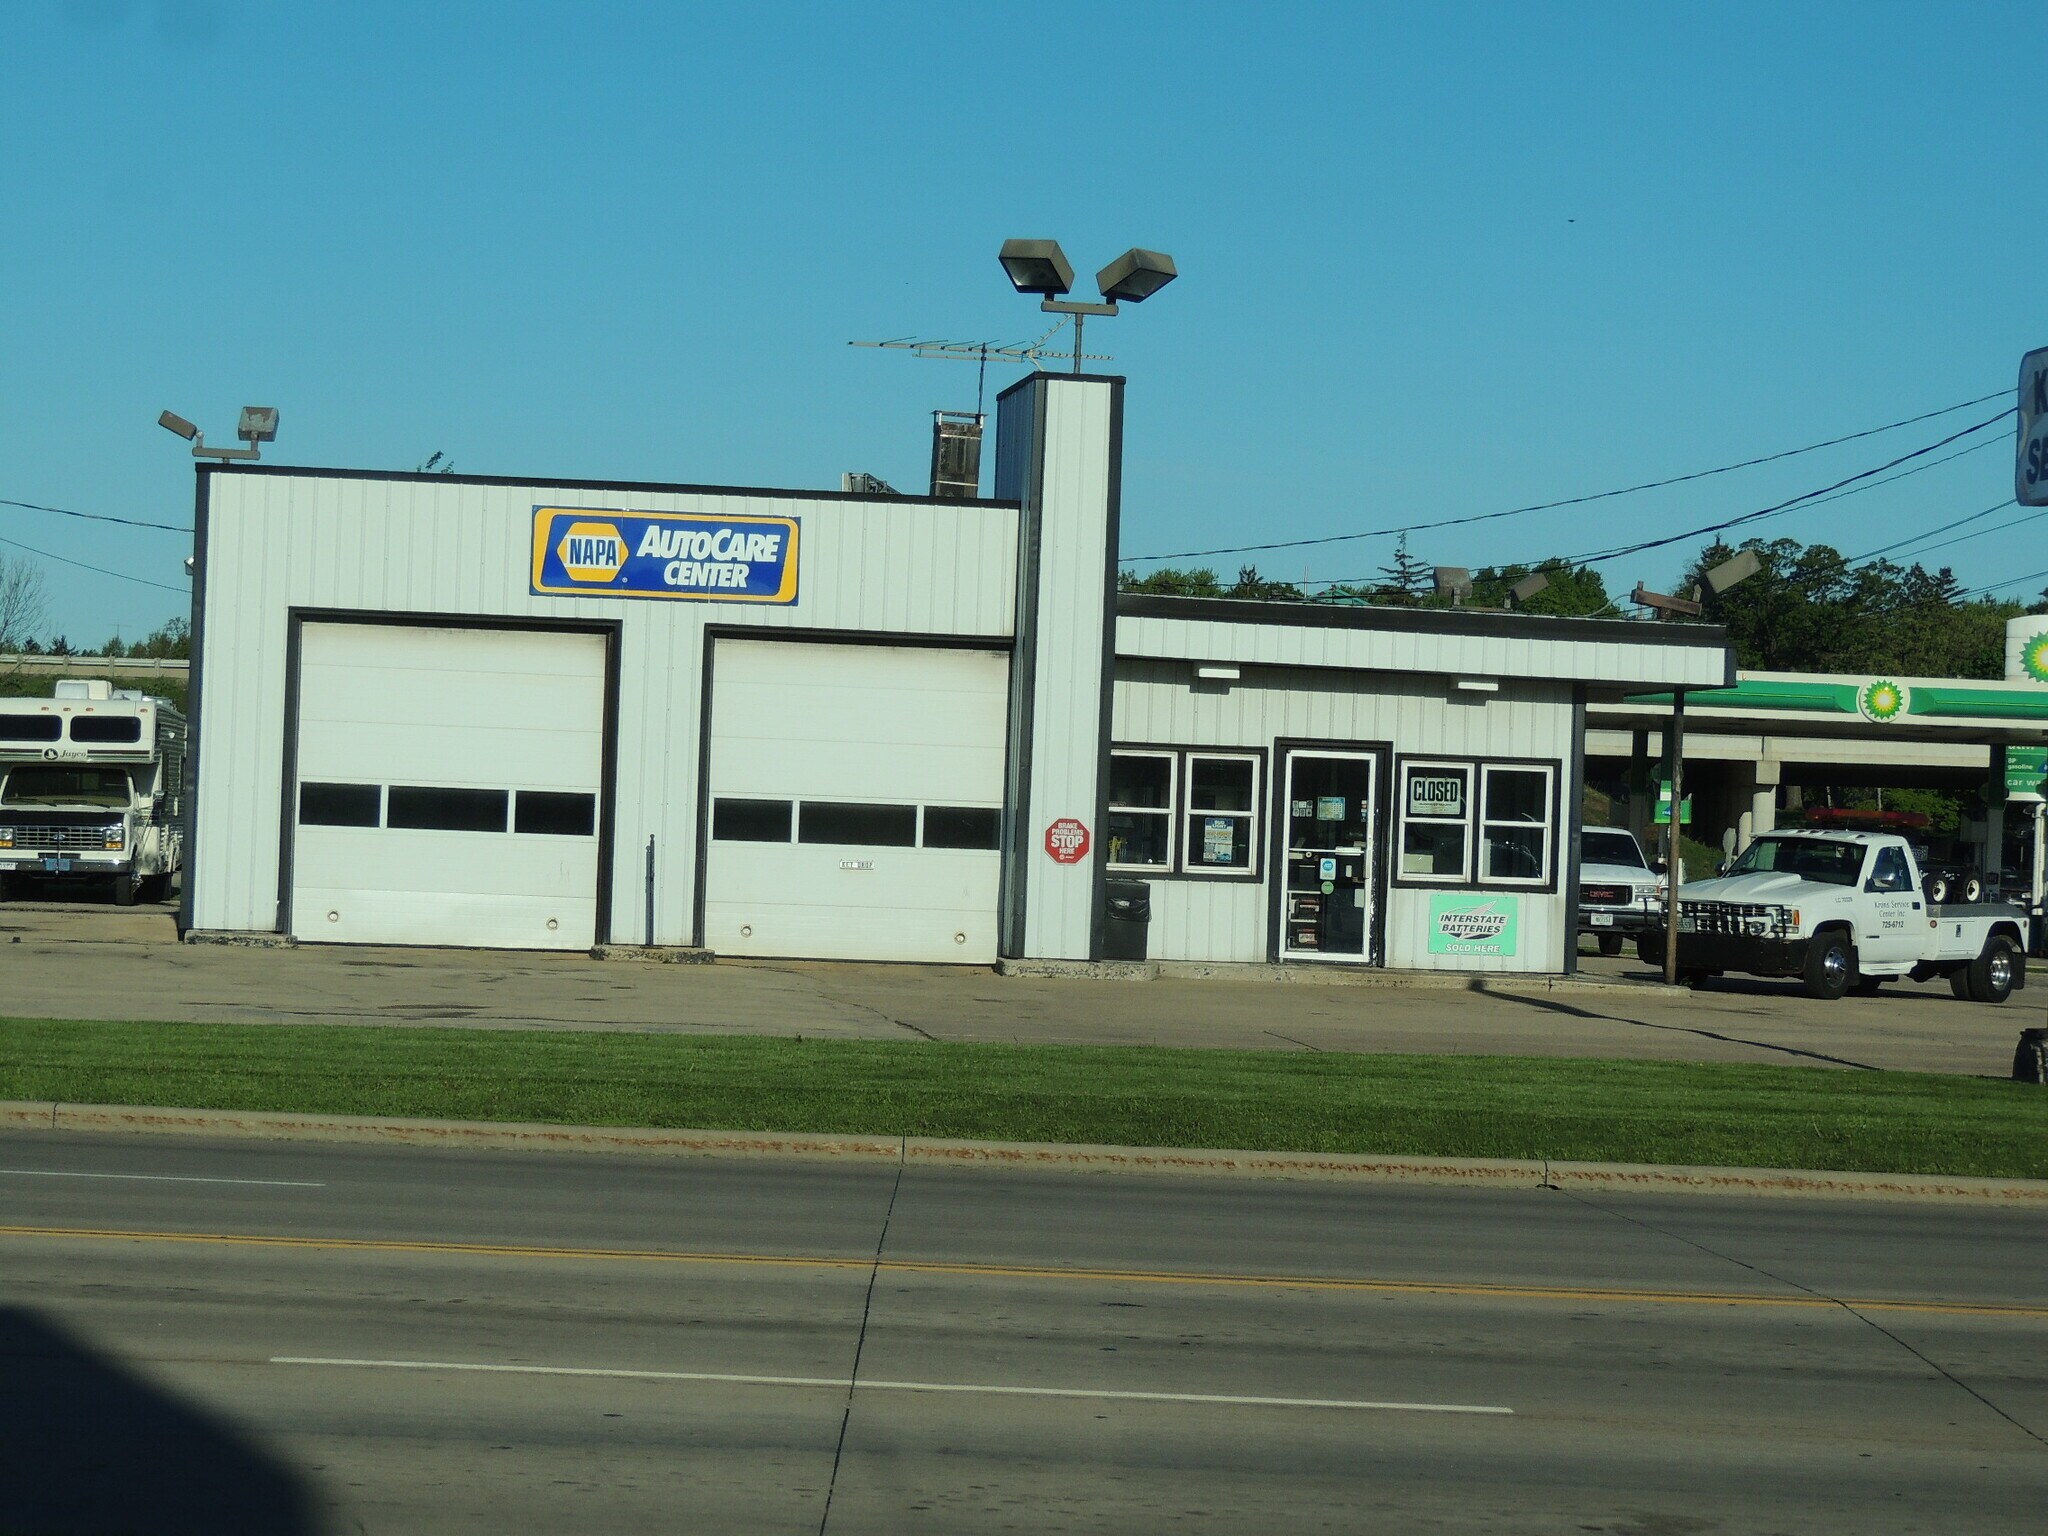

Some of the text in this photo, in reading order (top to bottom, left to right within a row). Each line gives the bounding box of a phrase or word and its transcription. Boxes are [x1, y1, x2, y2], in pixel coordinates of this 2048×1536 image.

[569, 538, 617, 566] NAPA
[663, 561, 749, 588] CENTER
[61, 750, 87, 758] Jayco
[1413, 780, 1458, 802] CLOSED
[1051, 828, 1084, 836] PROBLEMS
[1051, 834, 1084, 848] STOP
[1590, 890, 1614, 898] GMC
[1440, 914, 1506, 924] INTERSTATE
[1879, 910, 1896, 918] Center
[1441, 924, 1501, 933] BATTERIES
[1446, 943, 1499, 953] SOLD HERE
